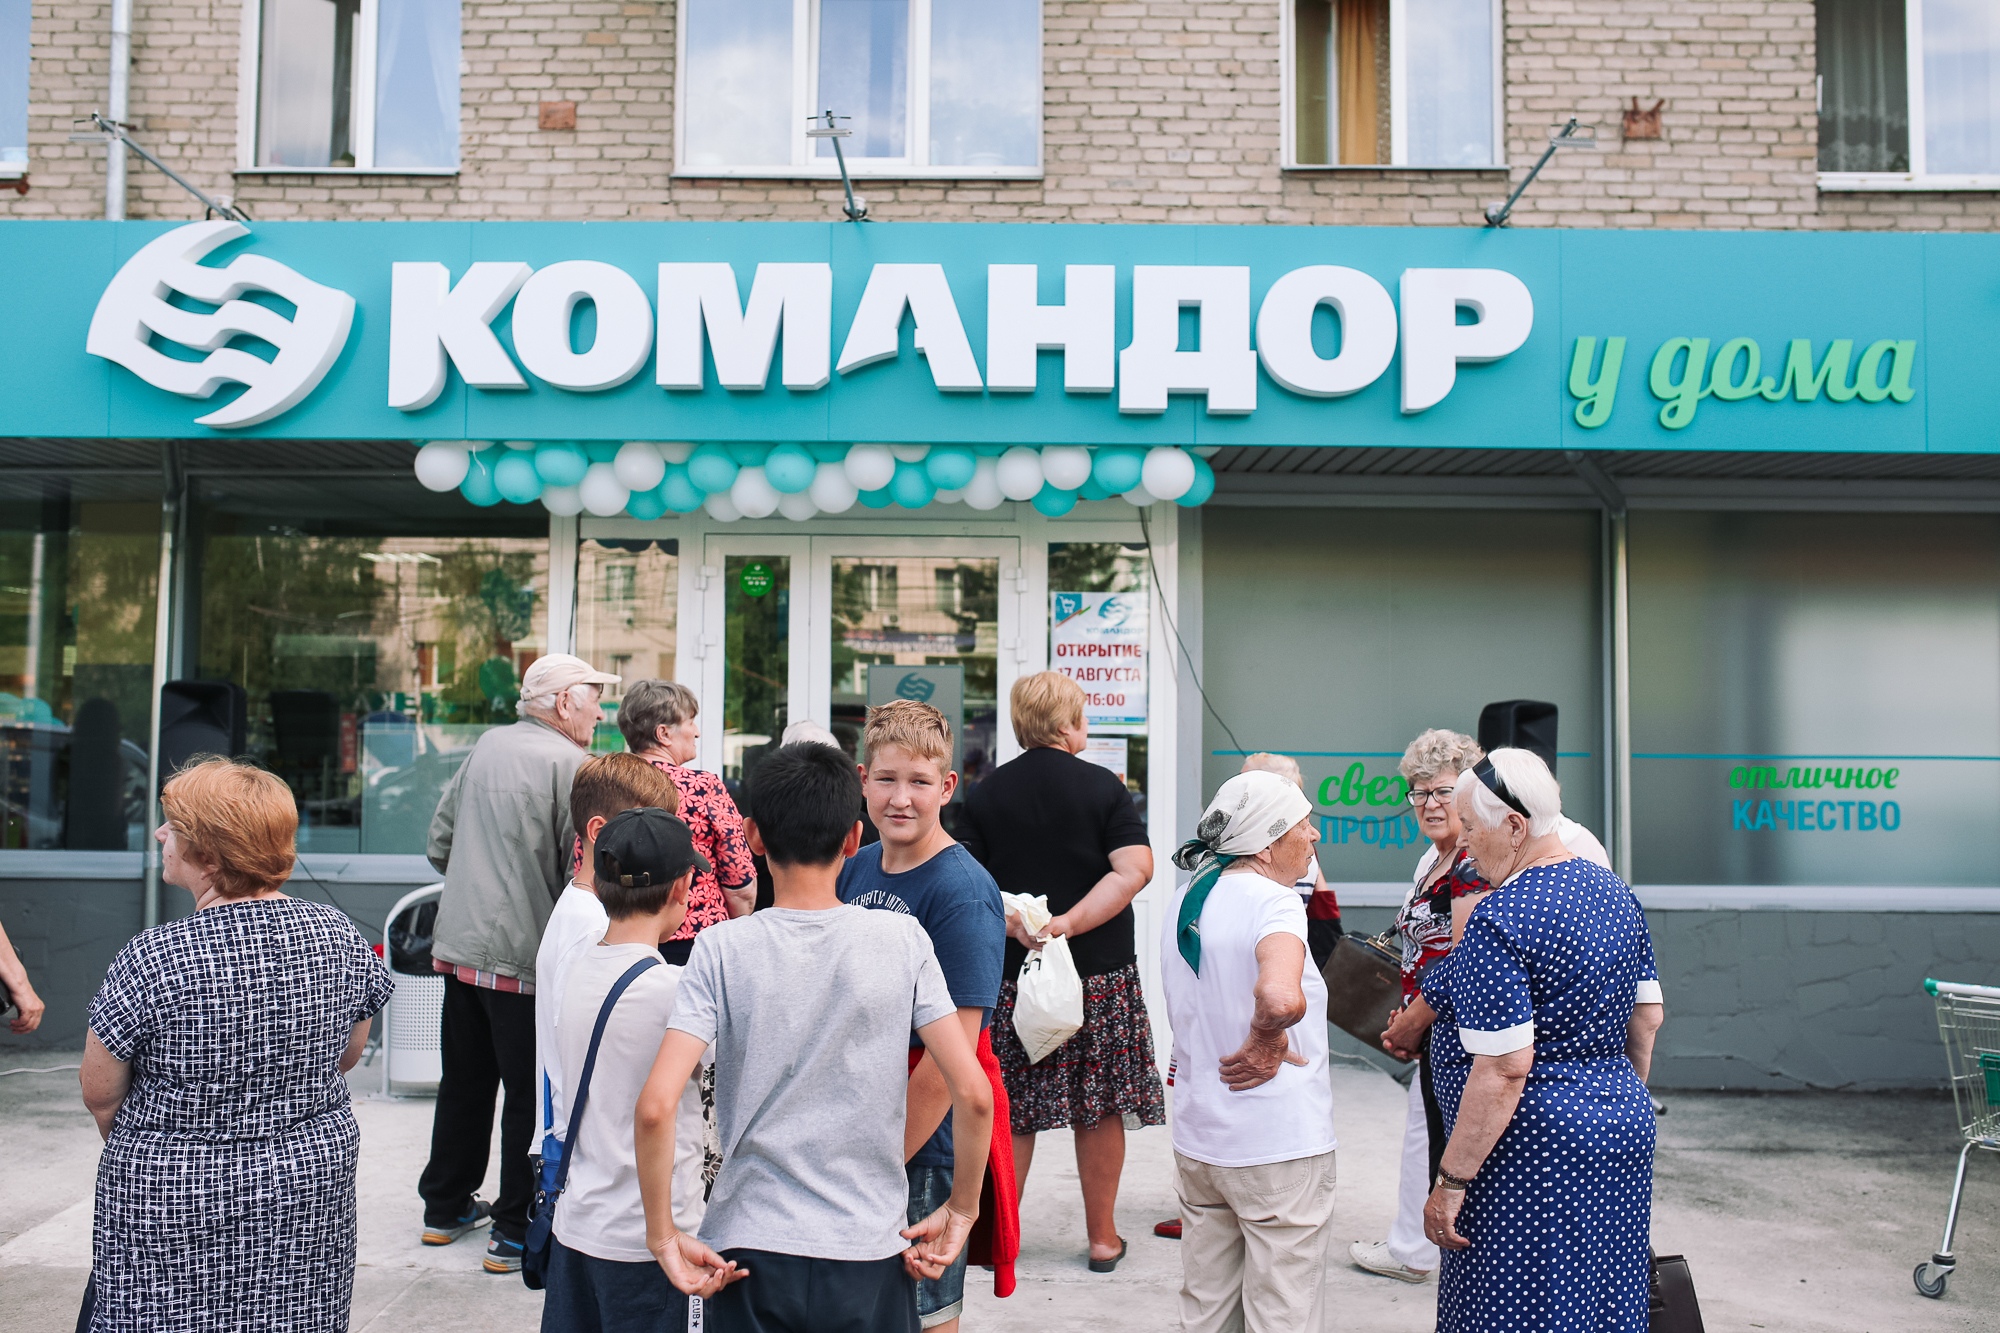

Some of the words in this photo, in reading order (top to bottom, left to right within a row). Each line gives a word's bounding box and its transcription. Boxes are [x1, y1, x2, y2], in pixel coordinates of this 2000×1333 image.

[388, 260, 1534, 414] КОМАНДОР
[1568, 335, 1627, 429] у
[1649, 336, 1917, 430] дома
[1057, 644, 1142, 658] ОТКРЫТИЕ
[1076, 667, 1141, 681] АВГУСТА
[1086, 693, 1125, 706] 16:00
[1729, 766, 1900, 789] отличное
[1733, 800, 1900, 831] КАЧЕСТВО
[1320, 815, 1431, 850] ПРОДУ
[850, 890, 886, 906] UTHENTIC
[692, 1298, 701, 1319] CLUB
